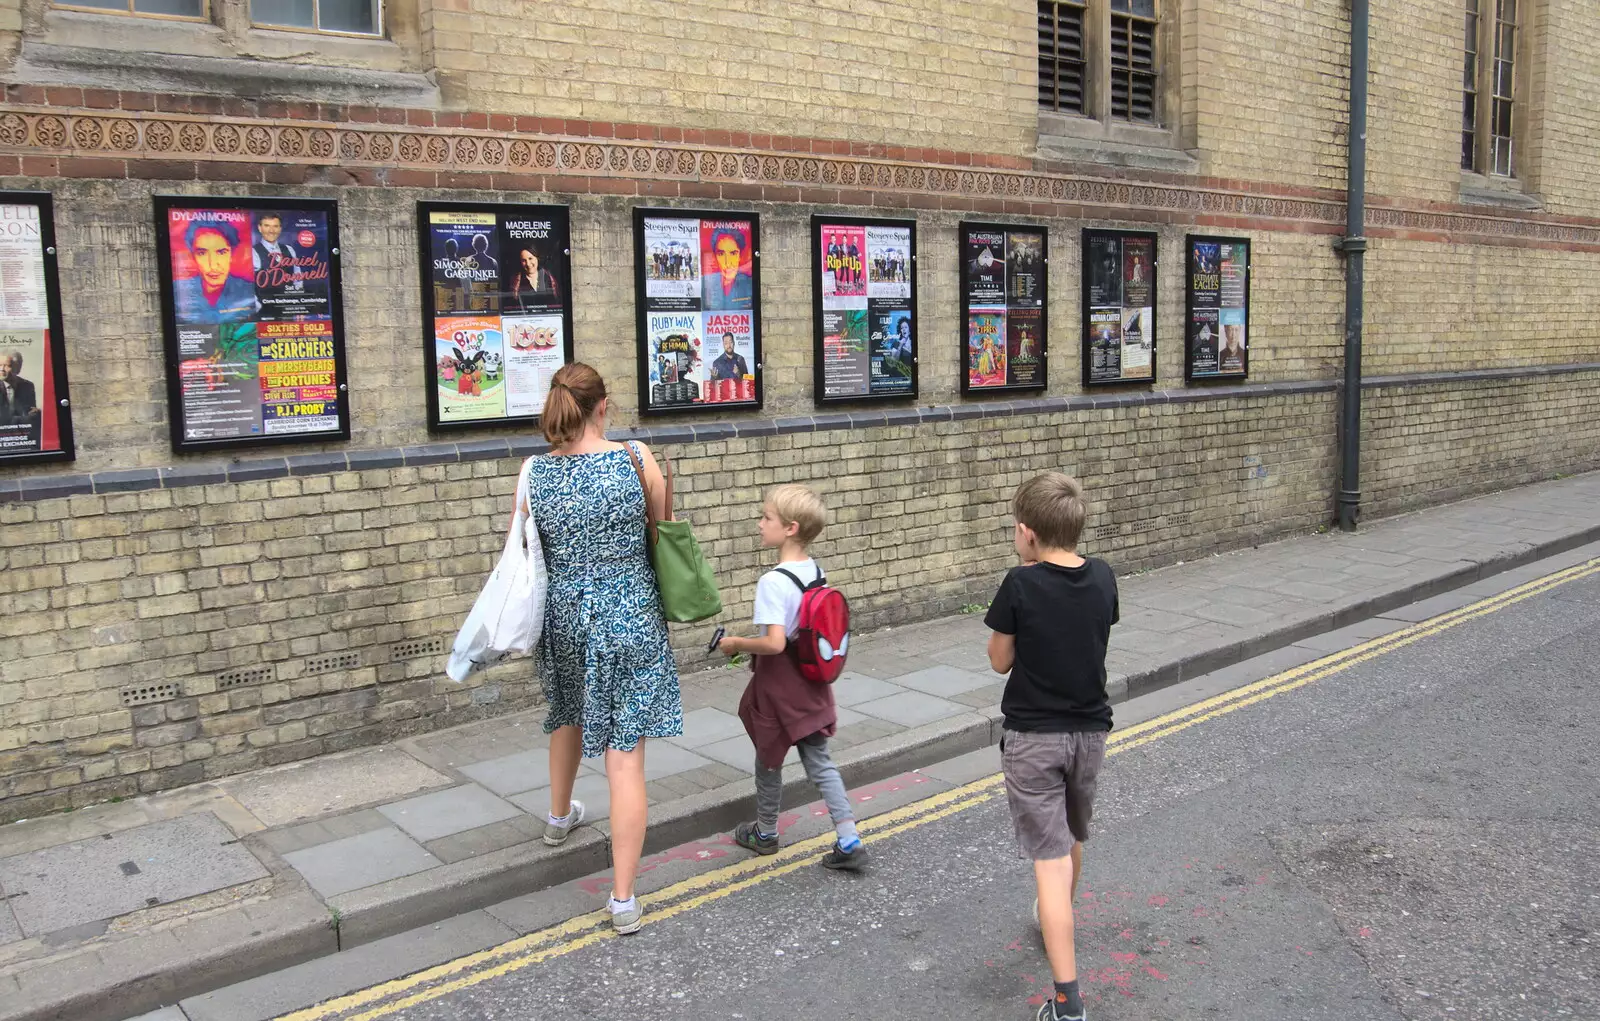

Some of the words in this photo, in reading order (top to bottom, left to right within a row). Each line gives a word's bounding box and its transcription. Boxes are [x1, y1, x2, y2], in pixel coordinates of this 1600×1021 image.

[172, 212, 206, 220] DYLAN
[208, 212, 245, 222] MORAN
[506, 222, 551, 230] MADELEINE
[678, 224, 698, 233] Span
[510, 230, 548, 238] PEYROUX
[894, 232, 910, 241] Span
[268, 252, 318, 269] Daniel
[434, 259, 464, 269] SIMON
[828, 255, 841, 272] Rip
[849, 256, 862, 273] Up
[445, 268, 498, 278] GARFUNKEL
[1194, 280, 1218, 289] EAGLES
[652, 317, 673, 332] RUBY
[675, 316, 694, 330] WAX
[707, 314, 749, 326] JASON
[267, 324, 300, 333] SIXTIES
[707, 326, 750, 335] MANFORD
[454, 331, 484, 347] Bing
[270, 341, 334, 359] SEARCHERS
[669, 342, 688, 350] HUMAN
[264, 365, 276, 373] THE
[276, 360, 333, 372] MERSEYBEATS
[280, 374, 331, 386] FORTUNES
